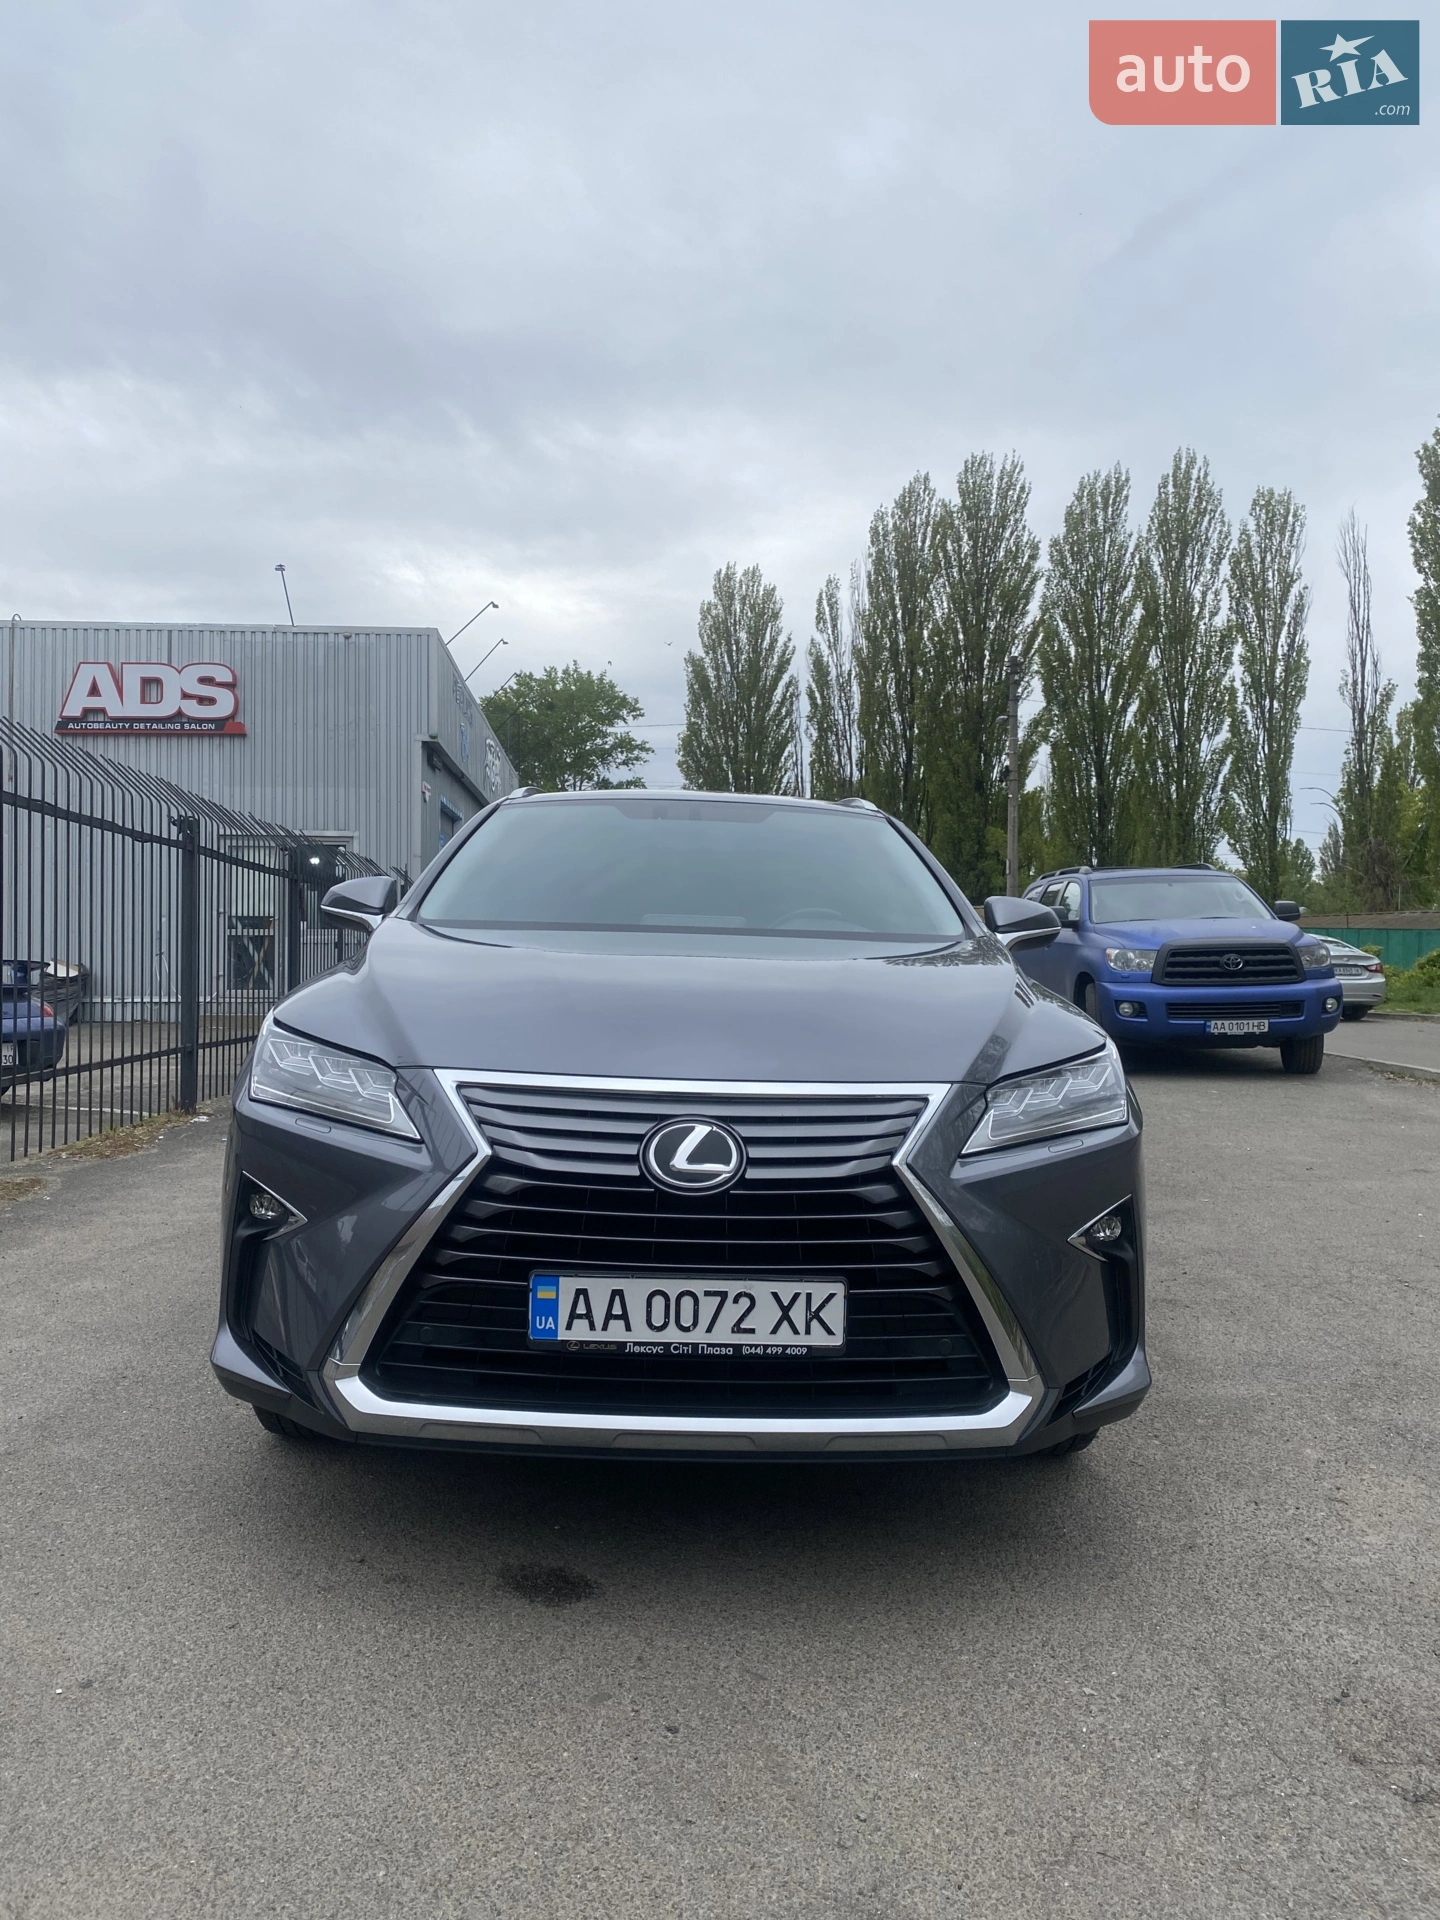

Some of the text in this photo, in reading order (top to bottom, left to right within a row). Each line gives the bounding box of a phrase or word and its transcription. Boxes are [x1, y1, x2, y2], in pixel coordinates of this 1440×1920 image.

[60, 662, 238, 719] ADS
[67, 722, 130, 730] AUTOBEAUTY
[133, 722, 181, 730] DETAILING
[1212, 1021, 1266, 1031] AA 0101 HB
[565, 1287, 838, 1336] AA 0072 XK
[536, 1316, 556, 1330] UA
[624, 1342, 807, 1355] Лексус Сіті Плаза (044) 499 4009
